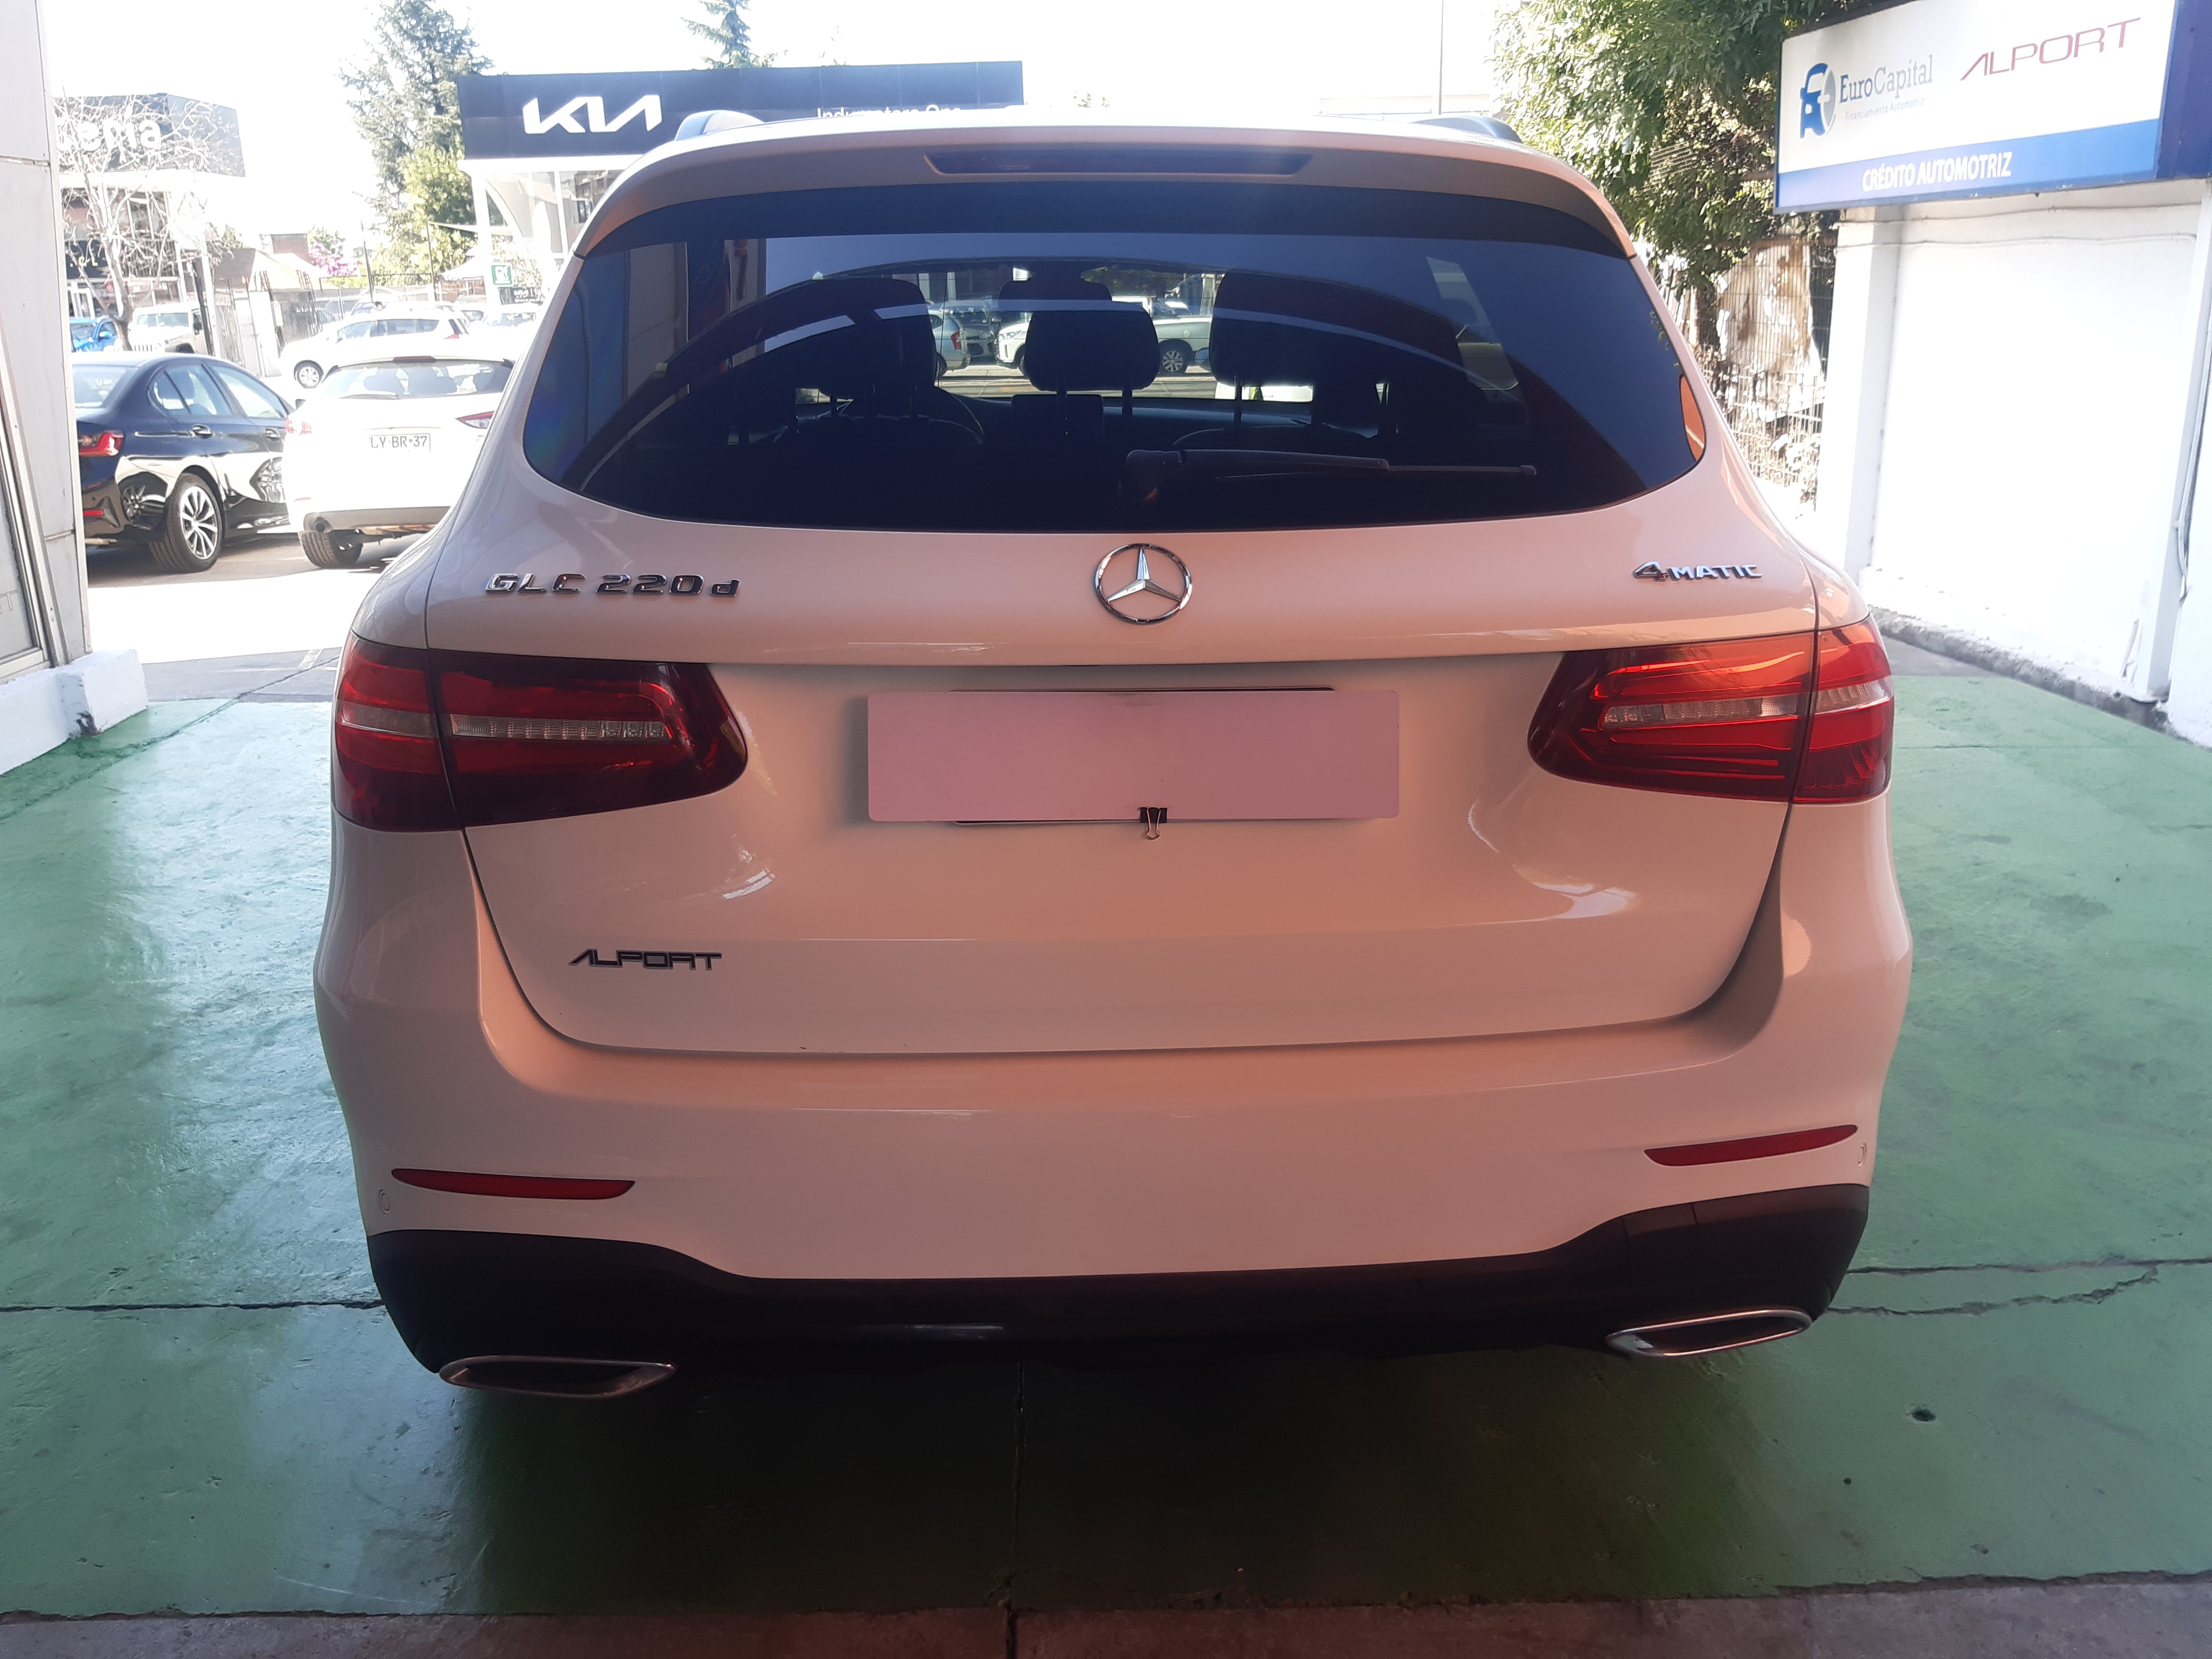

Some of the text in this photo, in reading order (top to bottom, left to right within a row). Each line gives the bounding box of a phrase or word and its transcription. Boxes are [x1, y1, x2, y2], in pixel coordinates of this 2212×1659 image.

[1960, 17, 2141, 81] ALPORT
[1839, 54, 1933, 104] EuroCapital
[522, 95, 662, 134] KIA
[1862, 151, 2013, 192] CRÉDITO AUTOMOTRIZ
[485, 573, 741, 598] GLC 220 d
[1632, 561, 1763, 582] 4MATIC
[568, 948, 722, 971] ALPORT
